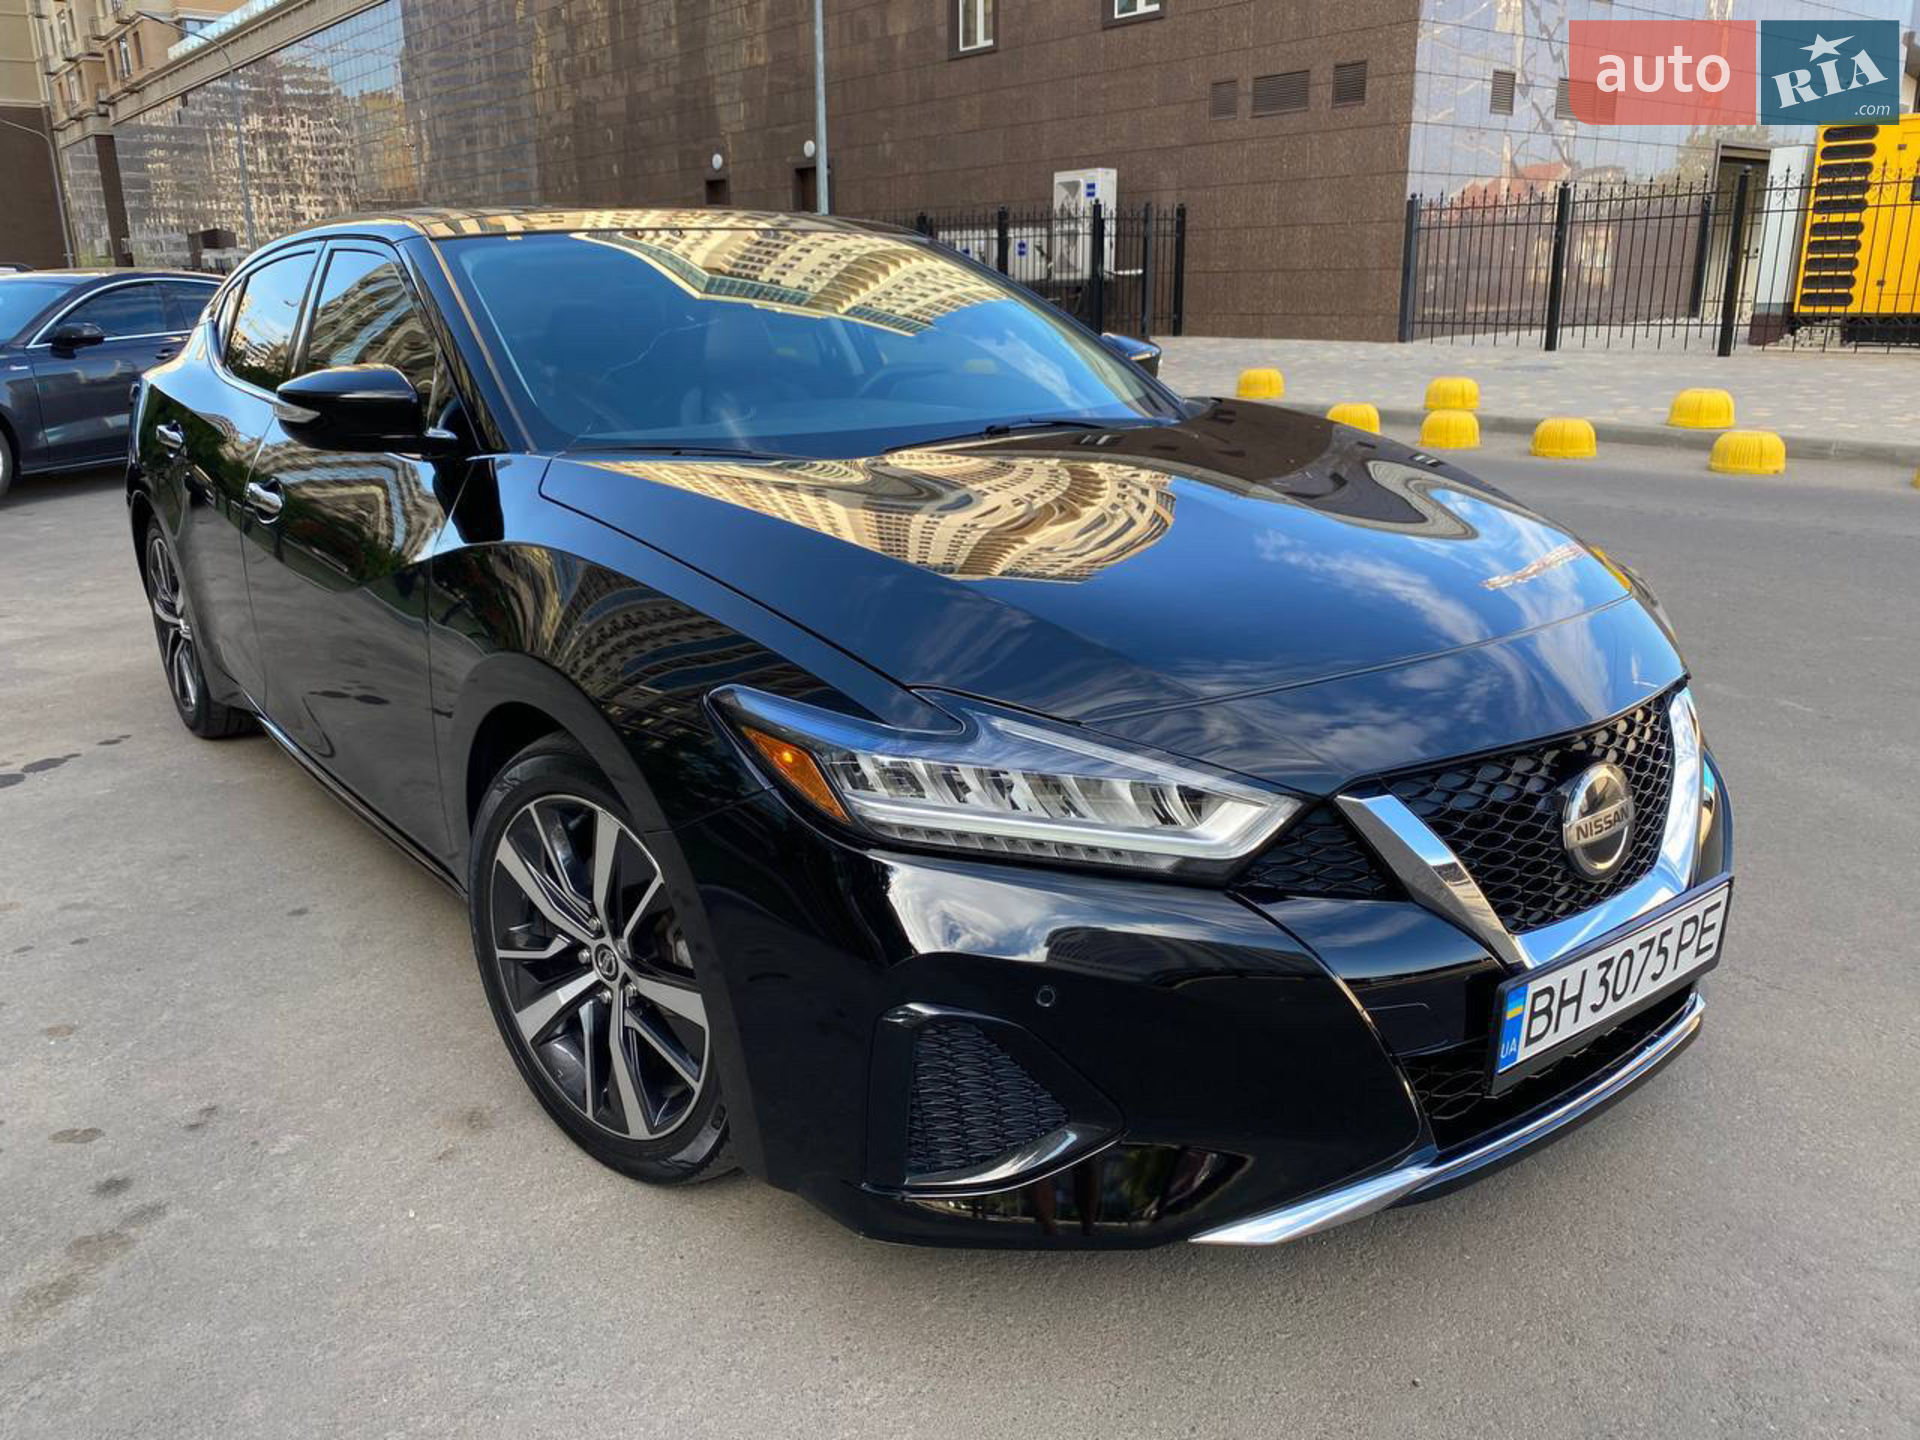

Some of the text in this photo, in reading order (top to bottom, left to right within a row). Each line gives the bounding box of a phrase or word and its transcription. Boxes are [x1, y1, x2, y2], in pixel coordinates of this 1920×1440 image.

[1576, 804, 1629, 841] NISSAN
[1524, 901, 1722, 1048] BH 3075 PE
[1501, 1037, 1517, 1058] UA
